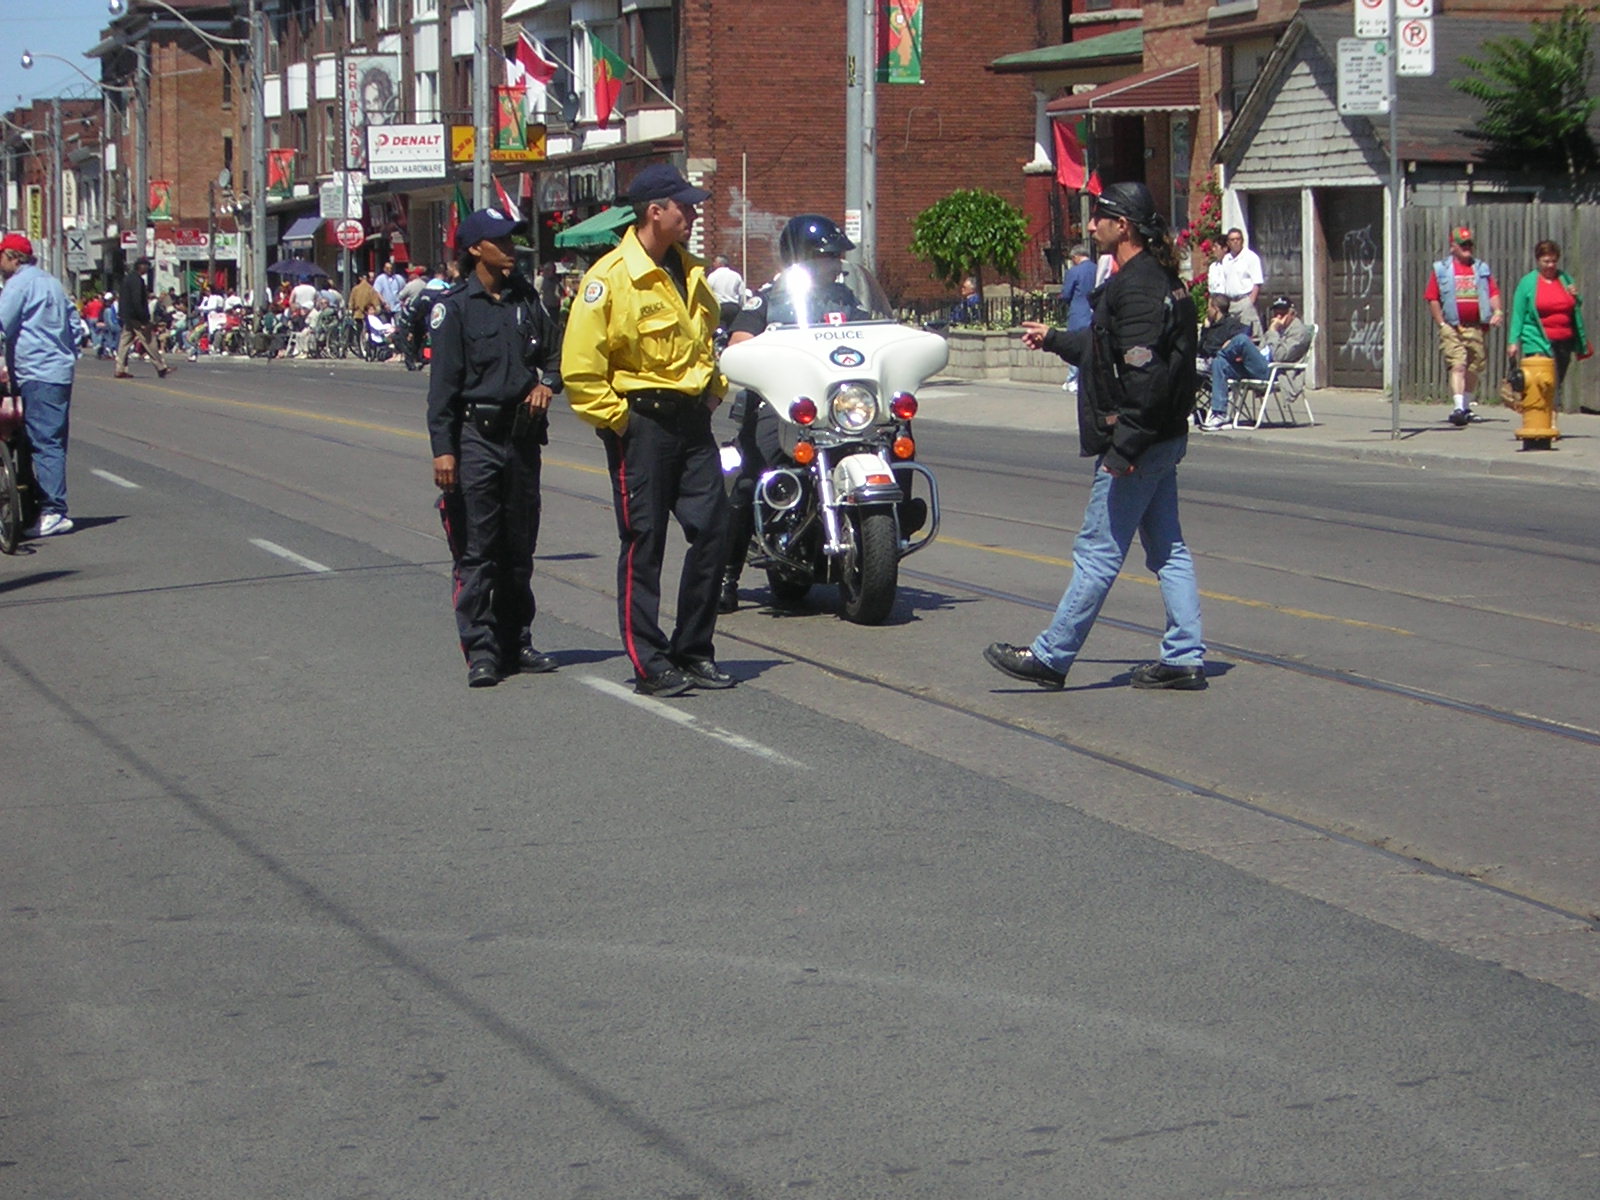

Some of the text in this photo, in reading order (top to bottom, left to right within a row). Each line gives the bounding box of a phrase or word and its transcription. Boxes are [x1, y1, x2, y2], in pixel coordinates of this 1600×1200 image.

[348, 63, 361, 157] CHRISTINAS
[392, 135, 441, 146] DENALT
[372, 163, 443, 175] LISBOA HARDWARE
[640, 302, 665, 316] POLICE
[814, 330, 865, 341] POLICE
